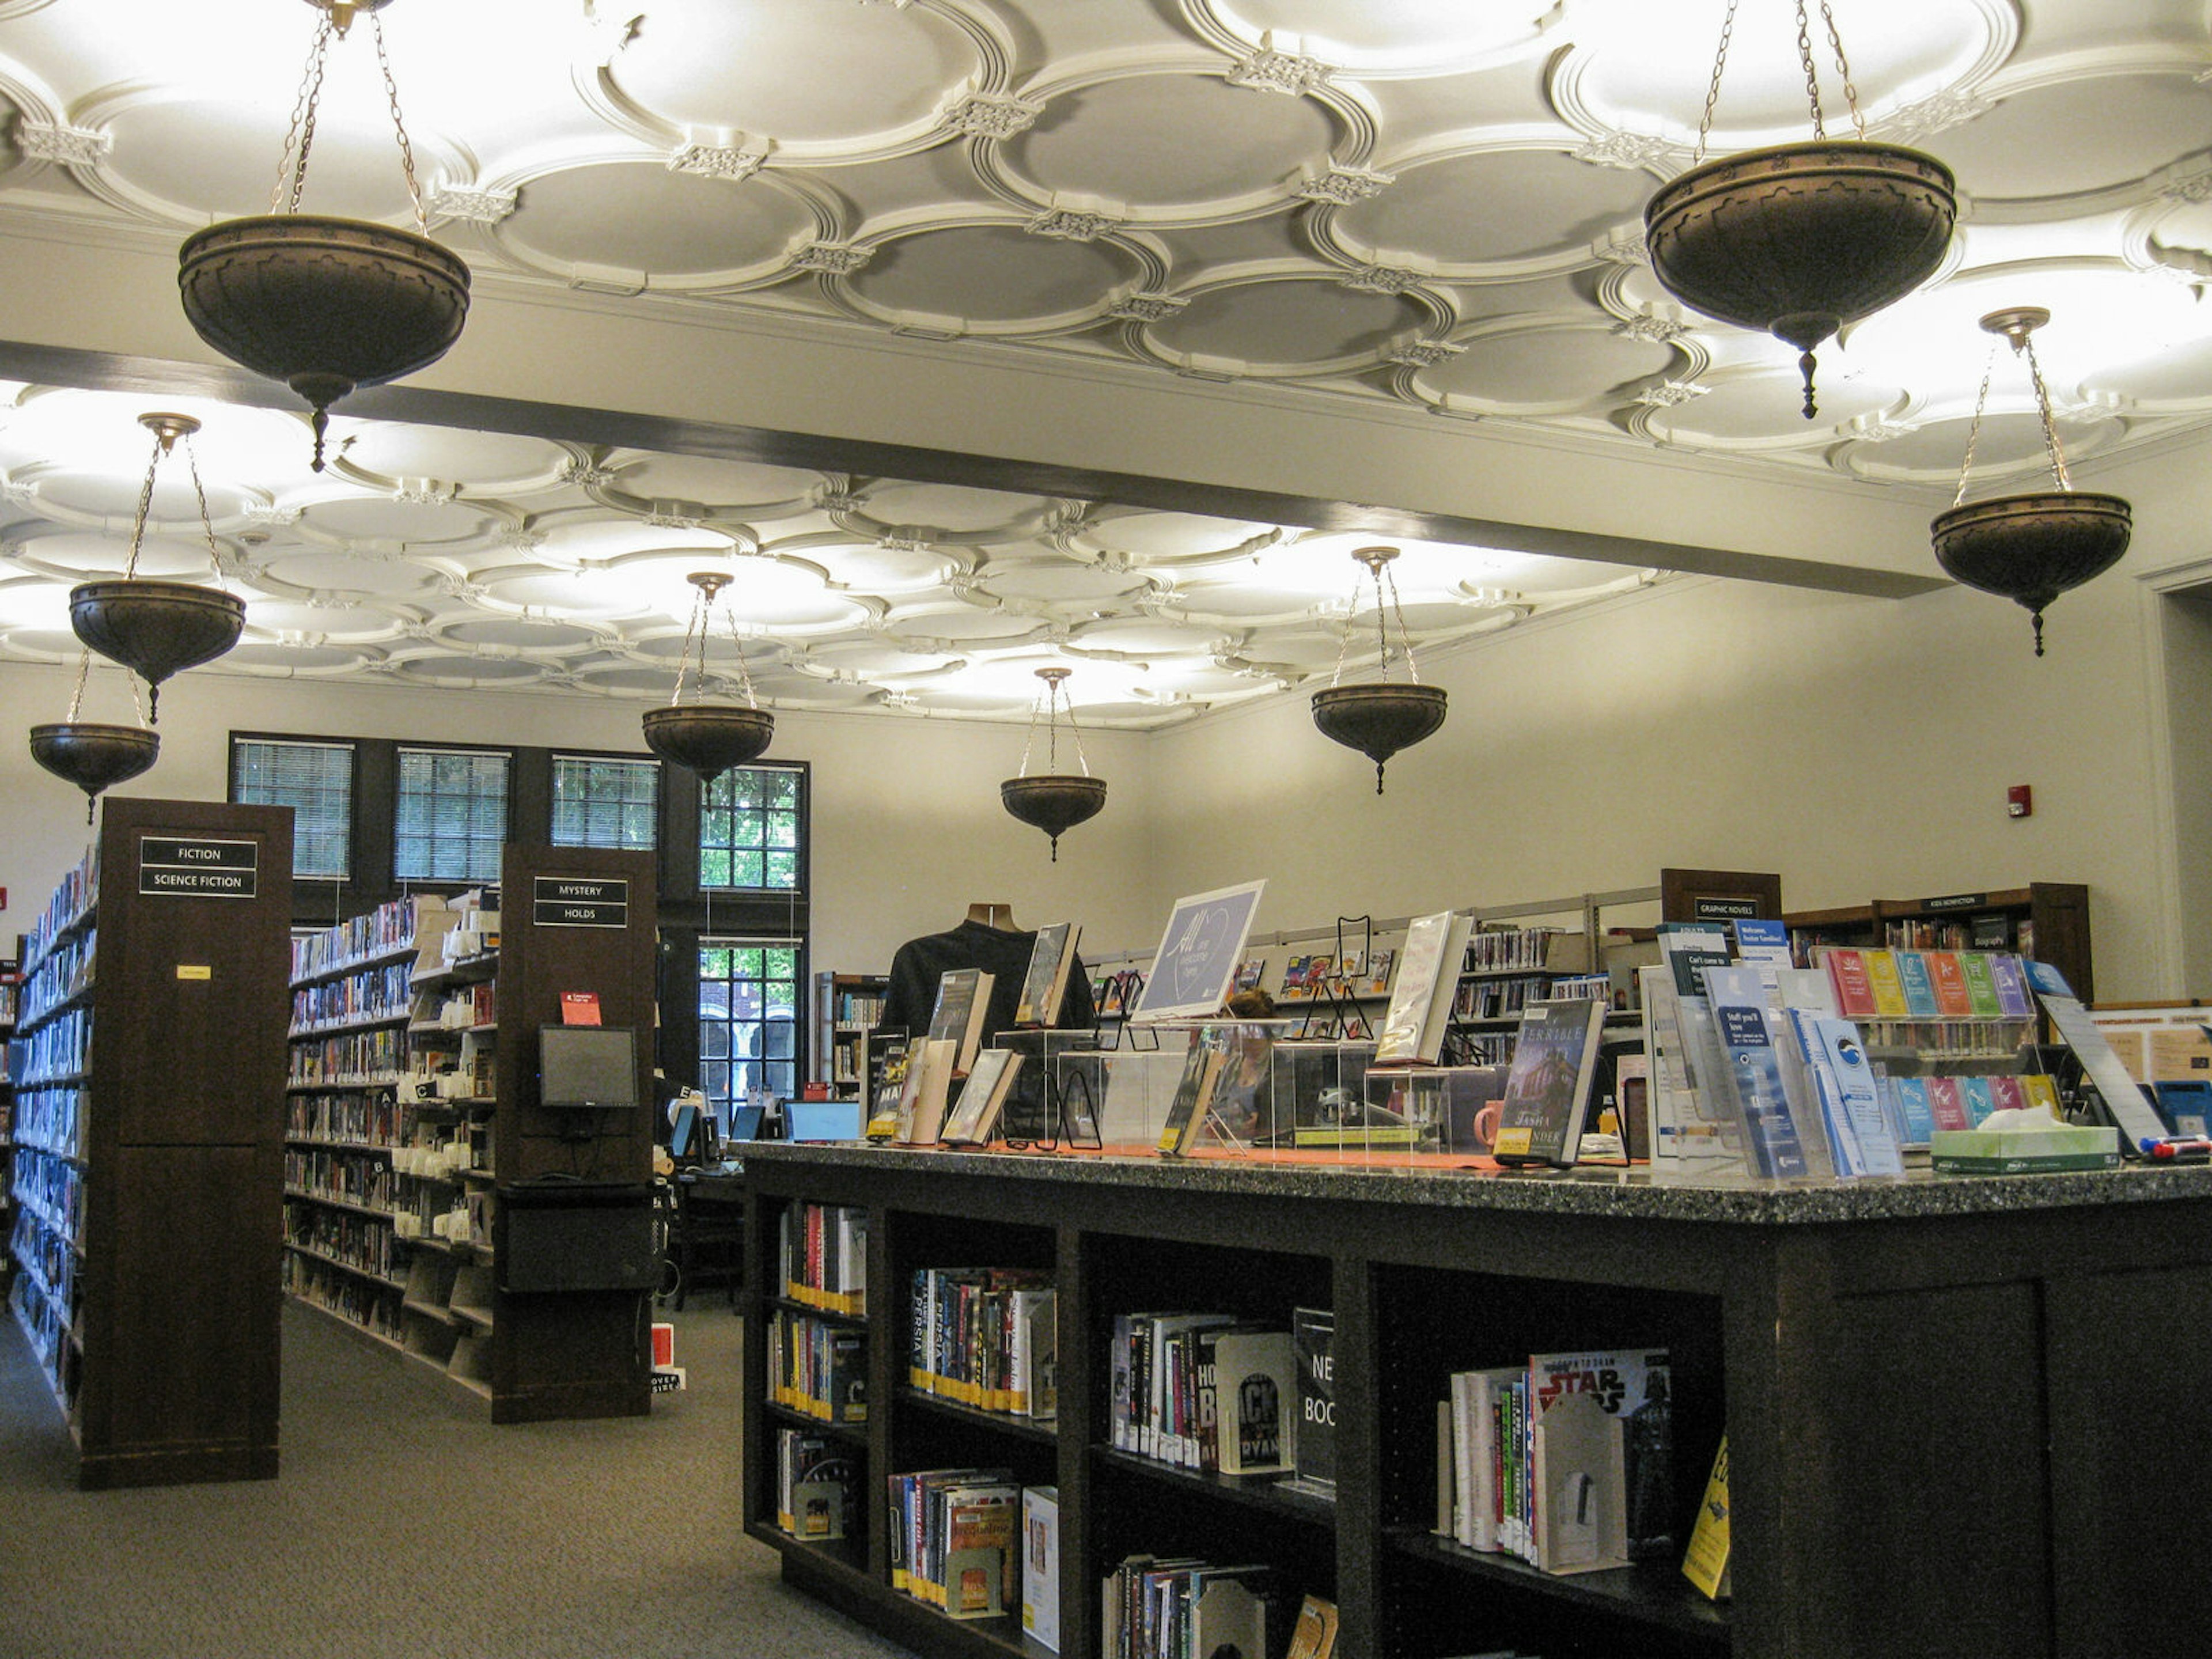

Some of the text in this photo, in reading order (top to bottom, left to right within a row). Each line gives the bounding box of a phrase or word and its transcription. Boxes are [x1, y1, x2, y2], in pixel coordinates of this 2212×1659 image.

[179, 848, 221, 860] FICTION
[154, 874, 241, 887] SCIENCE FICTION
[559, 885, 602, 896] MYSTERY
[564, 908, 596, 919] HOLDS
[1700, 904, 1753, 915] GRAPHIC NOVELS
[1521, 1025, 1582, 1041] TERRIBLE
[417, 1085, 427, 1097] C
[680, 1085, 691, 1099] E
[382, 1092, 391, 1104] A
[374, 1161, 384, 1173] B
[912, 1297, 922, 1352] PERSIA
[1312, 1354, 1334, 1381] NE
[1539, 1369, 1624, 1395] STAR
